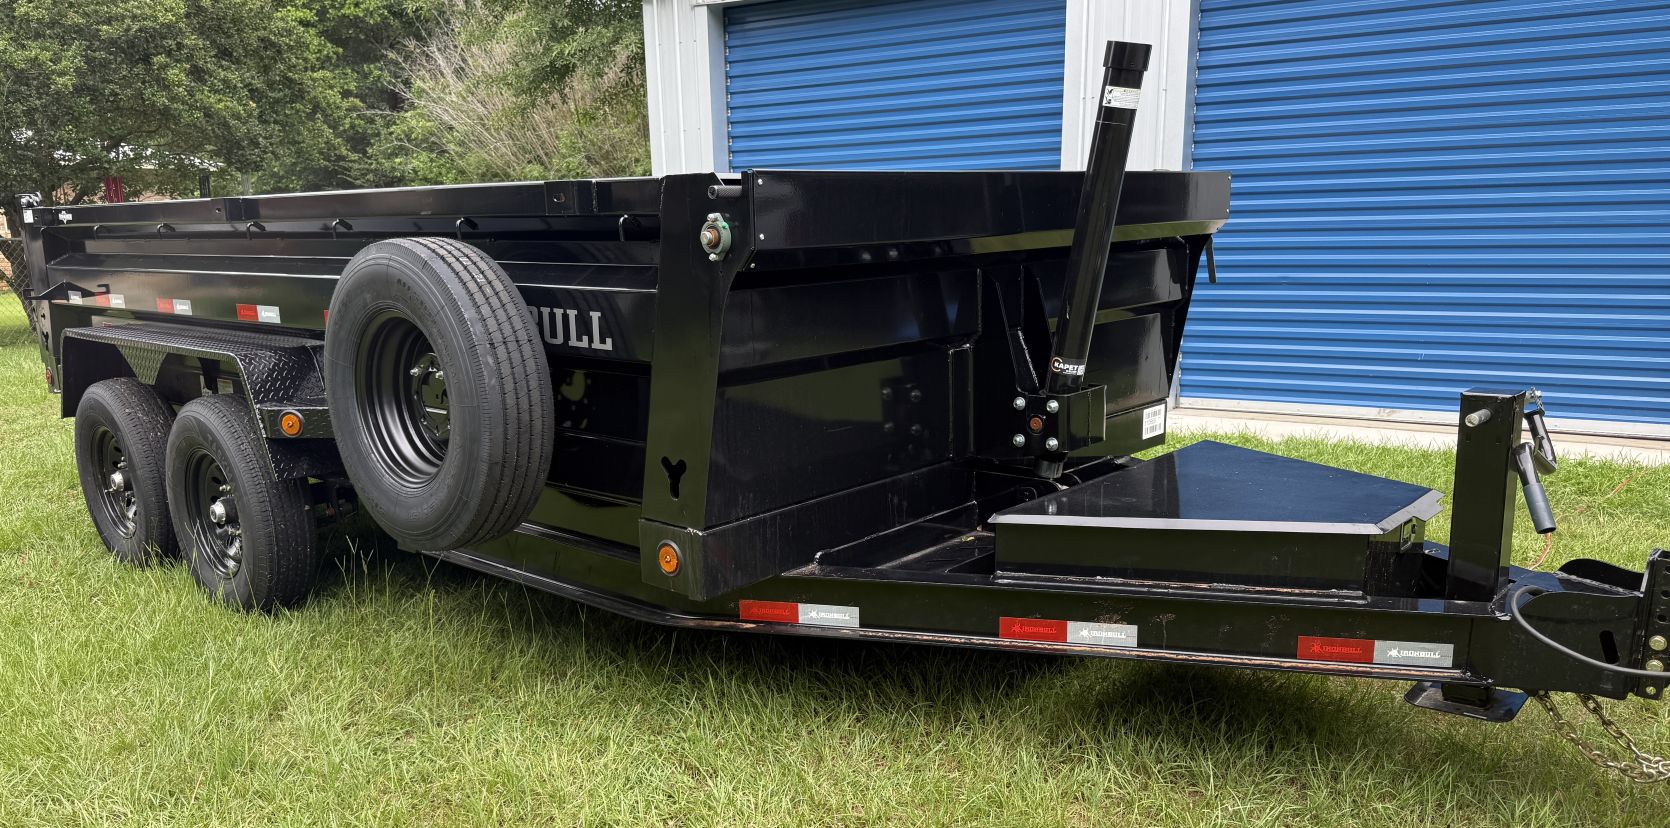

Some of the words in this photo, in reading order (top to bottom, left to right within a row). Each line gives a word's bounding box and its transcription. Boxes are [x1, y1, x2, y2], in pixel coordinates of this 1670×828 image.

[1090, 630, 1127, 638] IRONBULL
[1322, 645, 1362, 654] IRONBULL
[1400, 650, 1441, 659] IRONBULL
